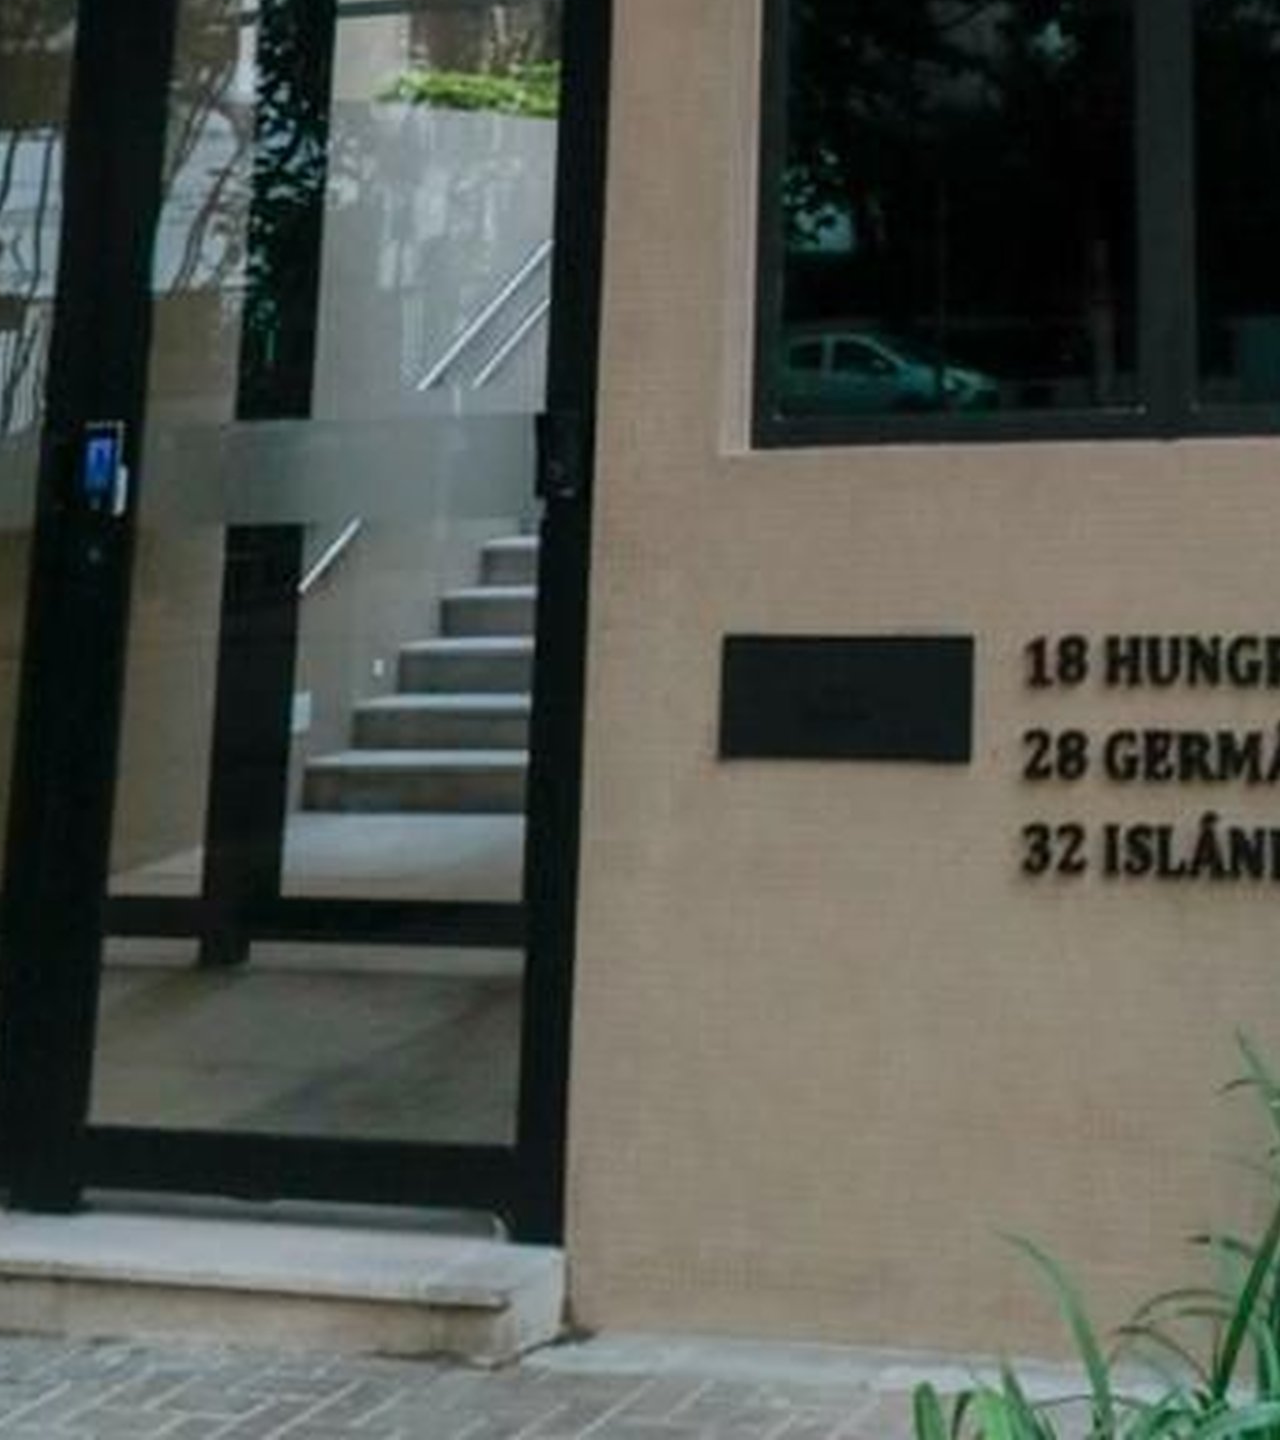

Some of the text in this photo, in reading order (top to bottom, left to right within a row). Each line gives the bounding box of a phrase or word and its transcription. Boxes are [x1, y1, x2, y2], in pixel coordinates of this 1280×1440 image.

[1020, 635, 1089, 689] 18
[1020, 730, 1090, 783] 28
[1020, 824, 1089, 877] 32
